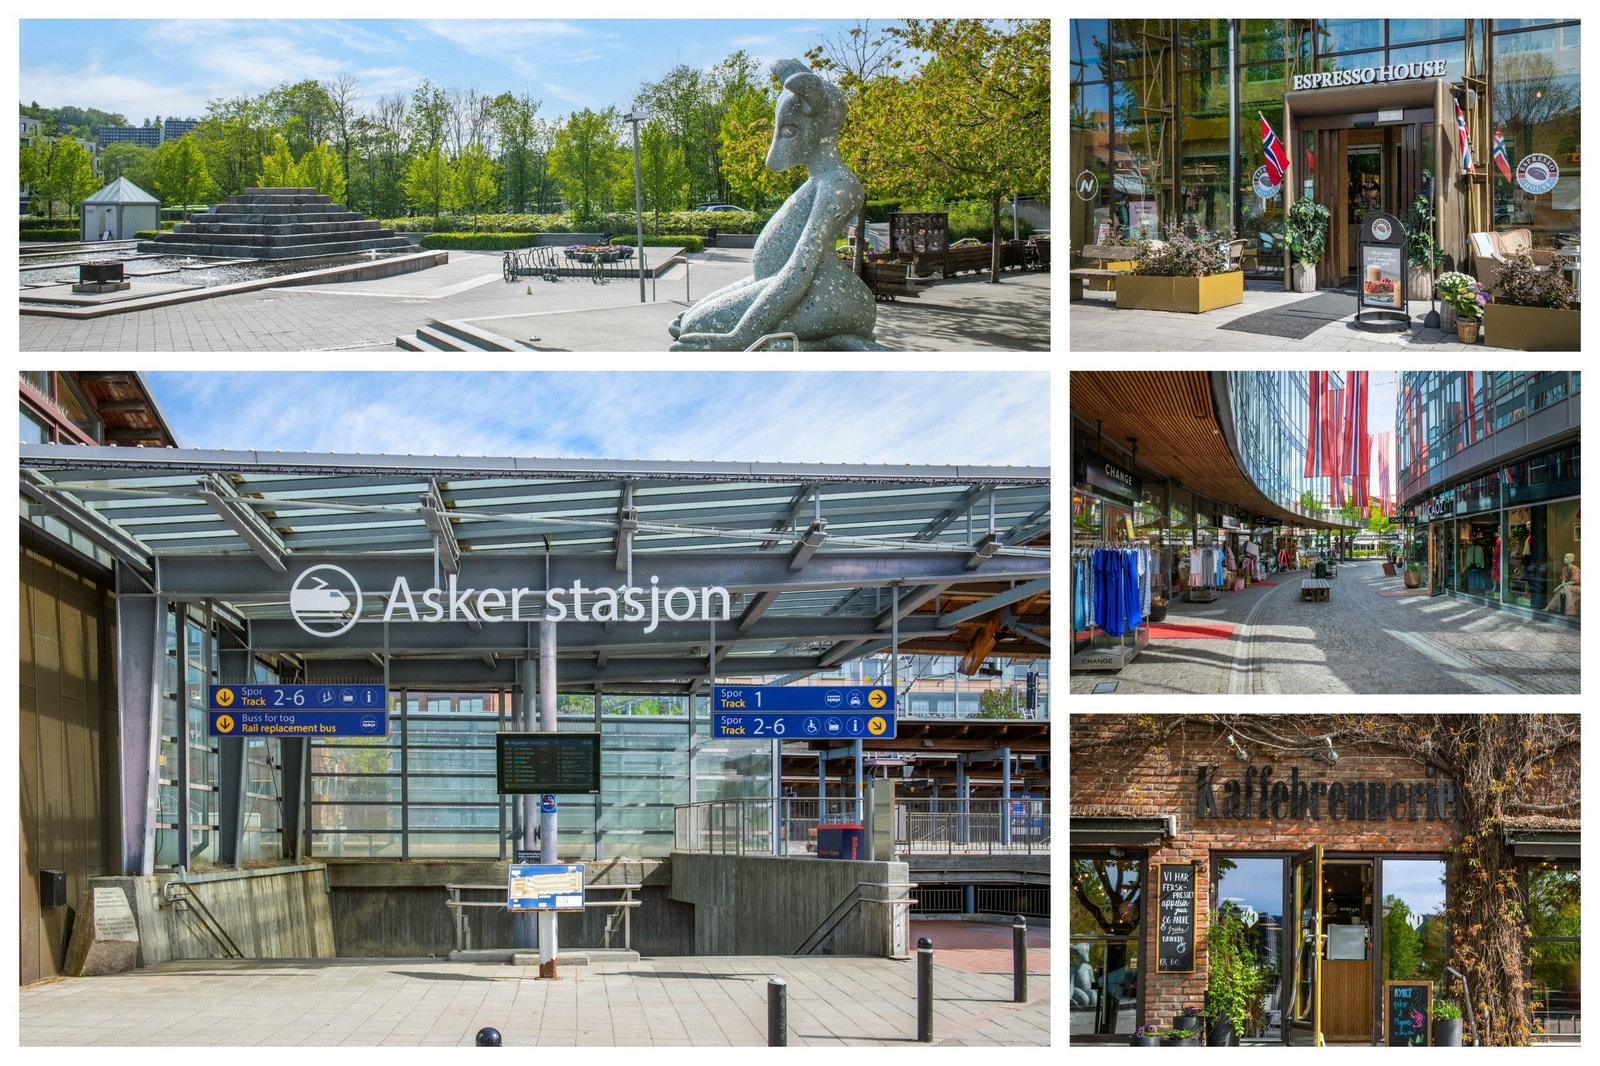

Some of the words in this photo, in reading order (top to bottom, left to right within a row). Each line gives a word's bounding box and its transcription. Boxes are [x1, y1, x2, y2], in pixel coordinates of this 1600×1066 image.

[1293, 67, 1376, 90] ESPRESSO
[1379, 59, 1447, 82] HOUSE
[1519, 156, 1555, 171] ESPRESSO
[1523, 180, 1552, 192] HOUSE
[1105, 464, 1132, 486] CHANGE
[382, 573, 530, 622] Asker
[545, 575, 730, 634] stasjon
[242, 687, 263, 697] Spor
[273, 689, 305, 706] 2-6
[721, 689, 742, 699] Spor
[242, 697, 266, 706] Track
[721, 699, 746, 708] Track
[754, 691, 762, 708] 1
[242, 714, 263, 722] Buss
[264, 713, 277, 722] for
[279, 714, 295, 724] tog
[721, 716, 742, 726] Spor
[242, 723, 259, 733] Rail
[260, 723, 318, 735] replacement
[319, 723, 336, 733] bus
[721, 726, 746, 735] Track
[753, 718, 786, 735] 2-6
[1163, 871, 1172, 881] VI
[1174, 872, 1189, 882] HAR
[1162, 883, 1187, 892] FERSK-
[1172, 891, 1194, 899] PRESSET
[1162, 916, 1171, 924] OG
